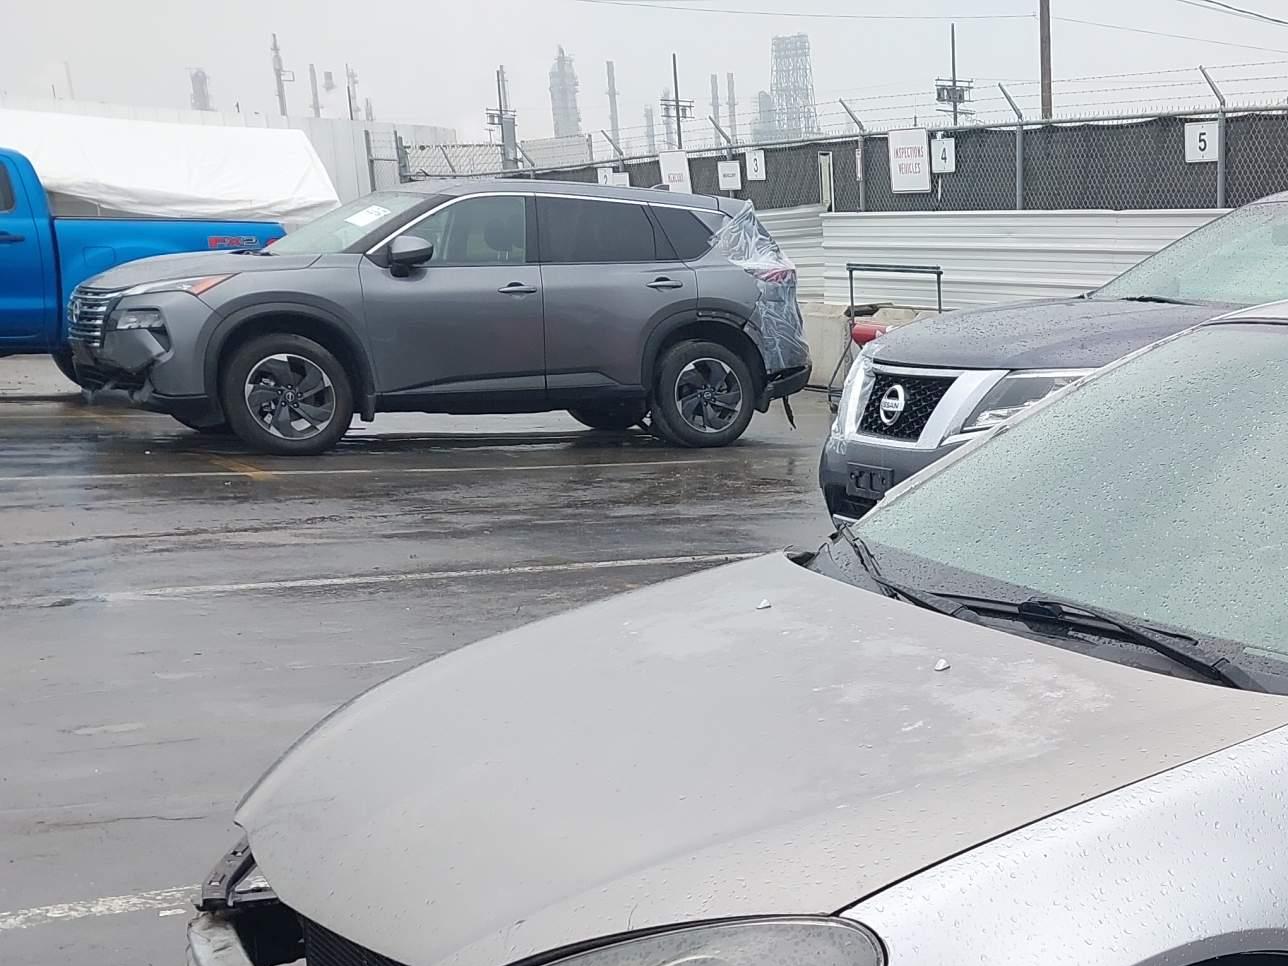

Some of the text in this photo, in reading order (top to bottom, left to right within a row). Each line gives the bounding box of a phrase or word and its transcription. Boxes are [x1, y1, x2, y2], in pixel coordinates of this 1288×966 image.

[1198, 132, 1208, 152] 5
[940, 147, 947, 163] 4
[753, 158, 759, 173] 3
